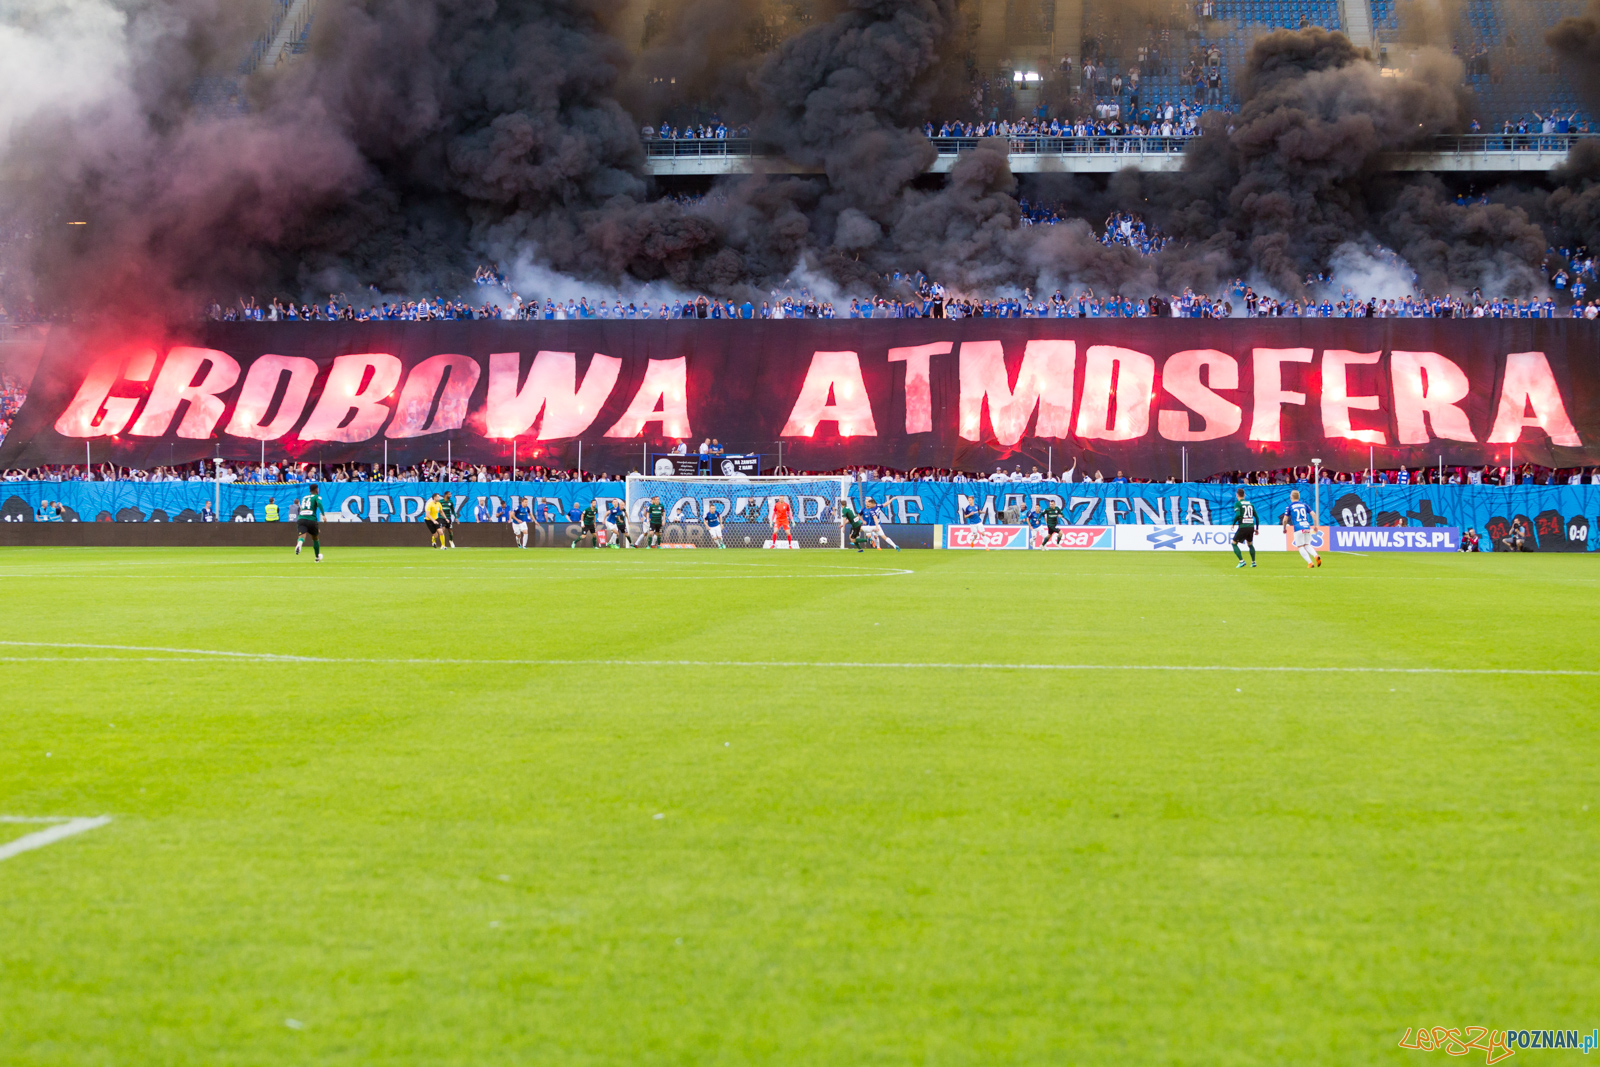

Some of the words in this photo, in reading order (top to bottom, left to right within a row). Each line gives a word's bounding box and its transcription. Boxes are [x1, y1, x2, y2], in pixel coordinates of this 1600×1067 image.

[55, 345, 693, 443] GROBOWA
[780, 339, 1583, 448] ATMOSFERA
[1241, 505, 1254, 518] 20
[1293, 507, 1307, 522] 29
[1341, 504, 1367, 527] 0:0
[953, 528, 1002, 546] tesa
[1336, 531, 1455, 547] WWW.STS.PL
[1569, 524, 1588, 542] 0:0
